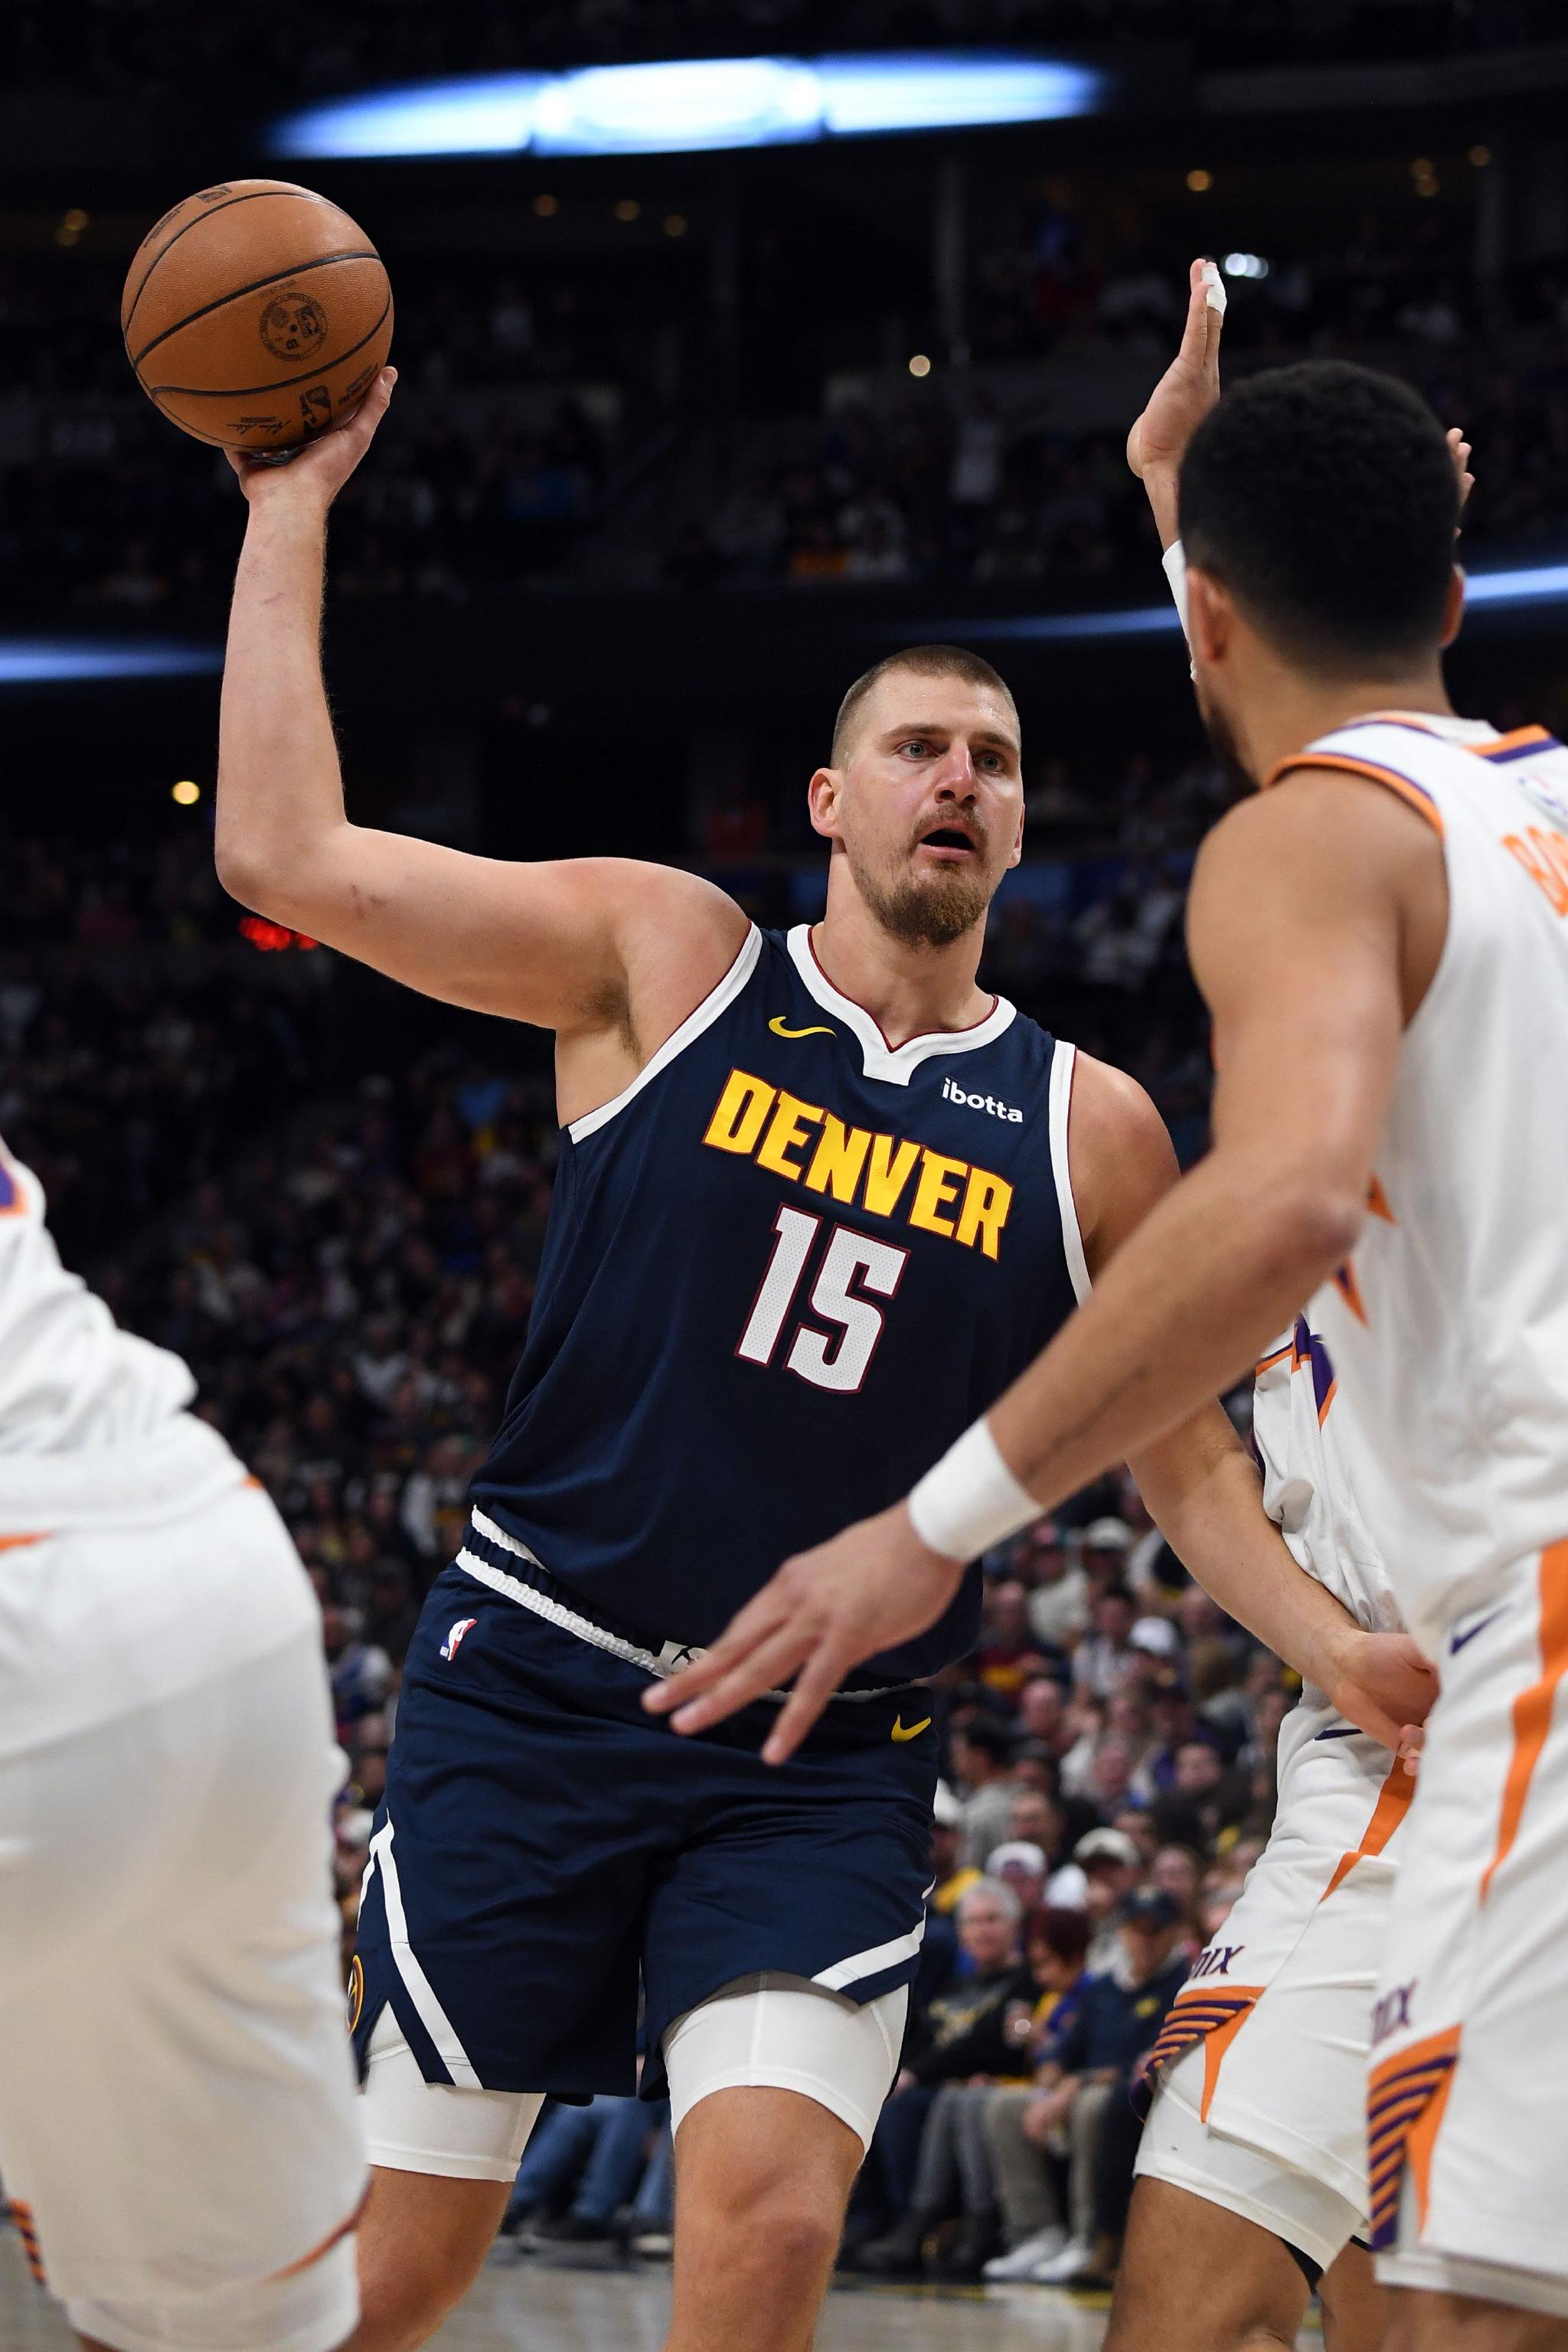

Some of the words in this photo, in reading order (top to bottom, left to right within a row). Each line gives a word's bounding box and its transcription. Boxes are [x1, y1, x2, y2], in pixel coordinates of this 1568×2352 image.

[701, 1067, 1014, 1263] DENVER
[942, 1076, 1024, 1123] ibotta
[734, 1202, 911, 1394] 15
